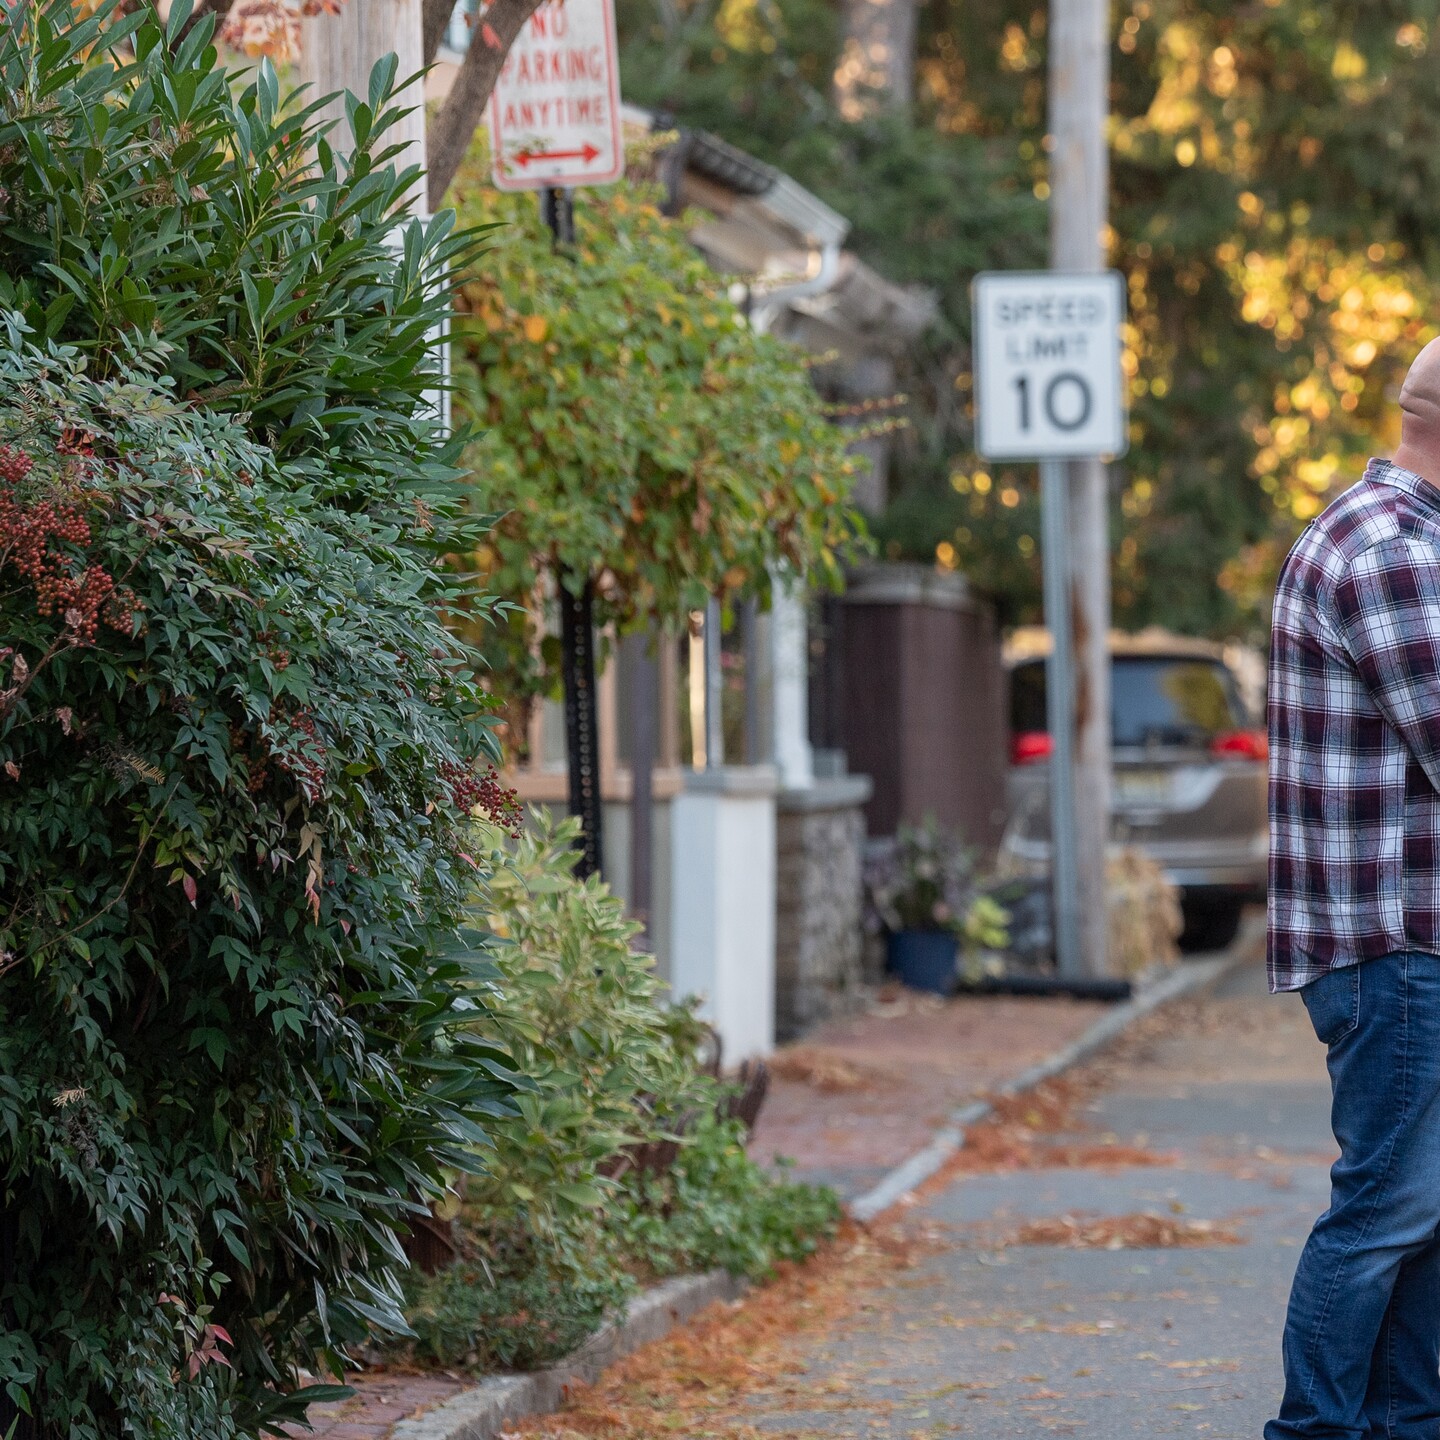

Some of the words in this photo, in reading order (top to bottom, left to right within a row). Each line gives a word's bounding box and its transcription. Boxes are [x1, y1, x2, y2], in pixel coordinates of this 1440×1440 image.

[530, 7, 568, 39] NO
[500, 47, 603, 84] PARKING
[504, 97, 604, 128] ANYTIME
[997, 297, 1104, 326] SPEED
[1006, 332, 1088, 362] LIMIT
[1013, 371, 1092, 433] 10
